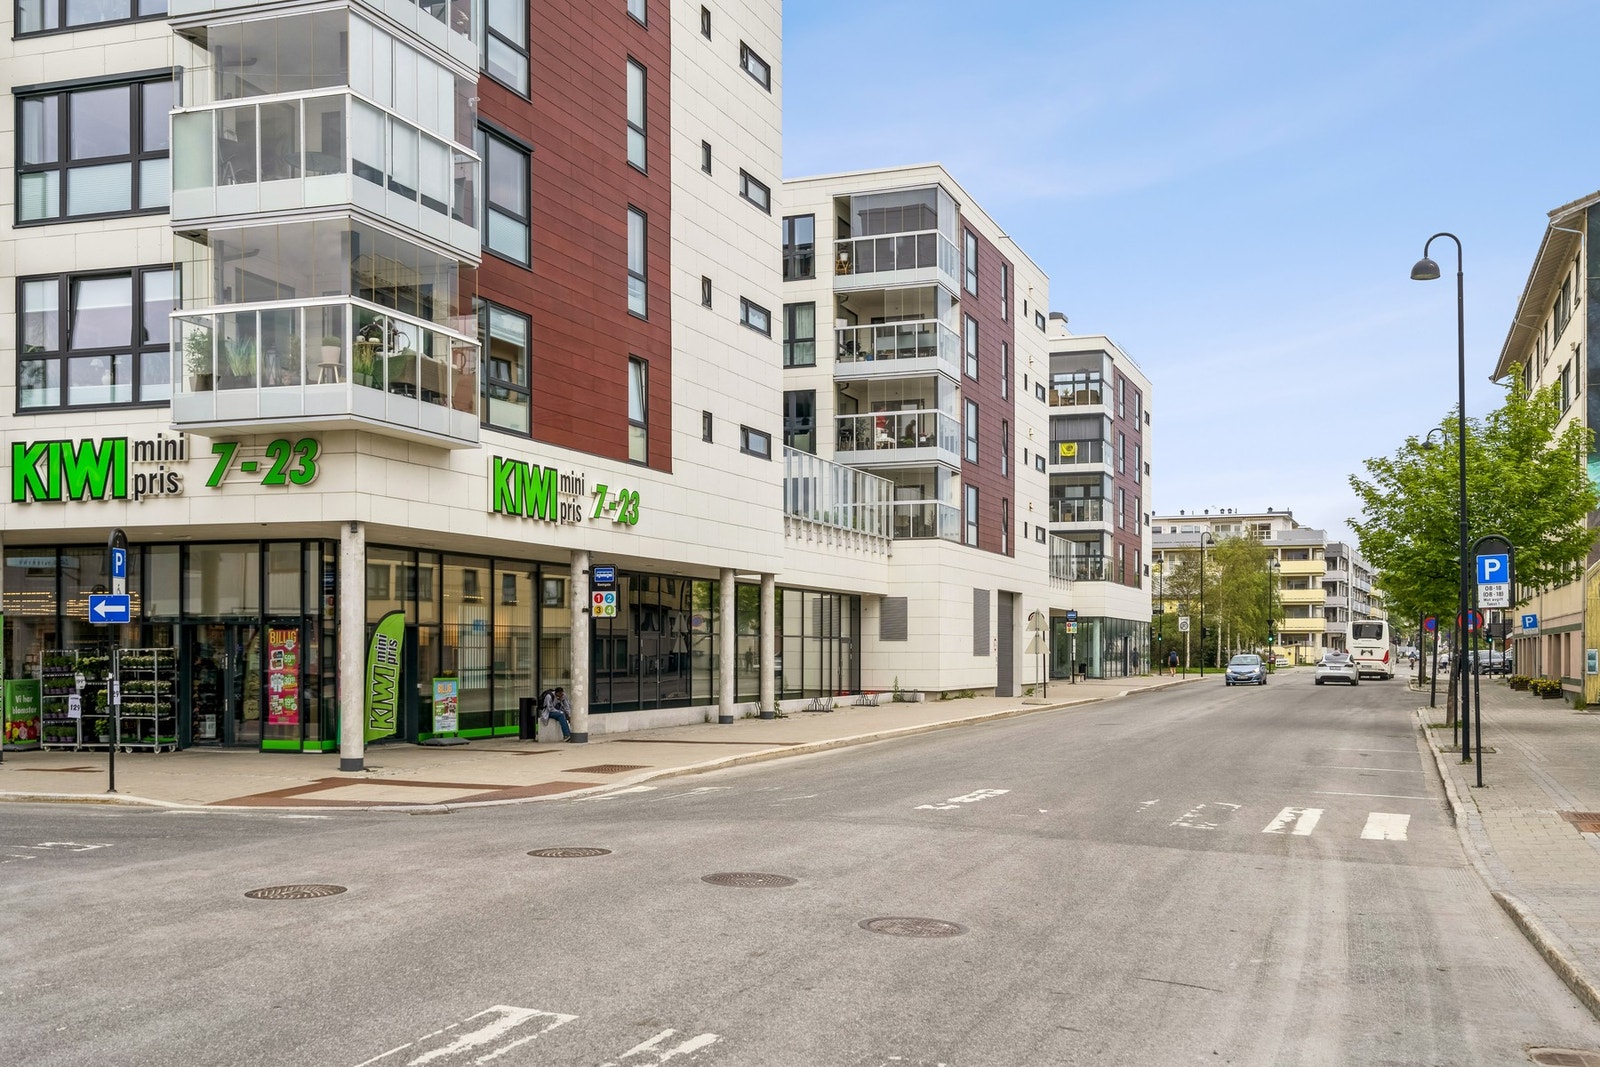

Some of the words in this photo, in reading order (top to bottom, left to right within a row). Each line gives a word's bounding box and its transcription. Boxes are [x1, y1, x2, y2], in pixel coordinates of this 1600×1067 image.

[134, 433, 185, 461] mini
[11, 436, 128, 503] KIWI
[134, 465, 180, 501] pris
[493, 455, 558, 521] KIWI
[560, 470, 585, 496] mini
[560, 498, 582, 525] pris
[115, 552, 123, 574] P
[1484, 558, 1501, 580] P
[1525, 616, 1534, 627] P
[269, 631, 297, 644] BILLIG
[376, 634, 388, 663] mini
[387, 640, 398, 666] pris
[15, 695, 22, 703] Vi
[22, 694, 33, 703] har
[370, 665, 396, 730] KIWI
